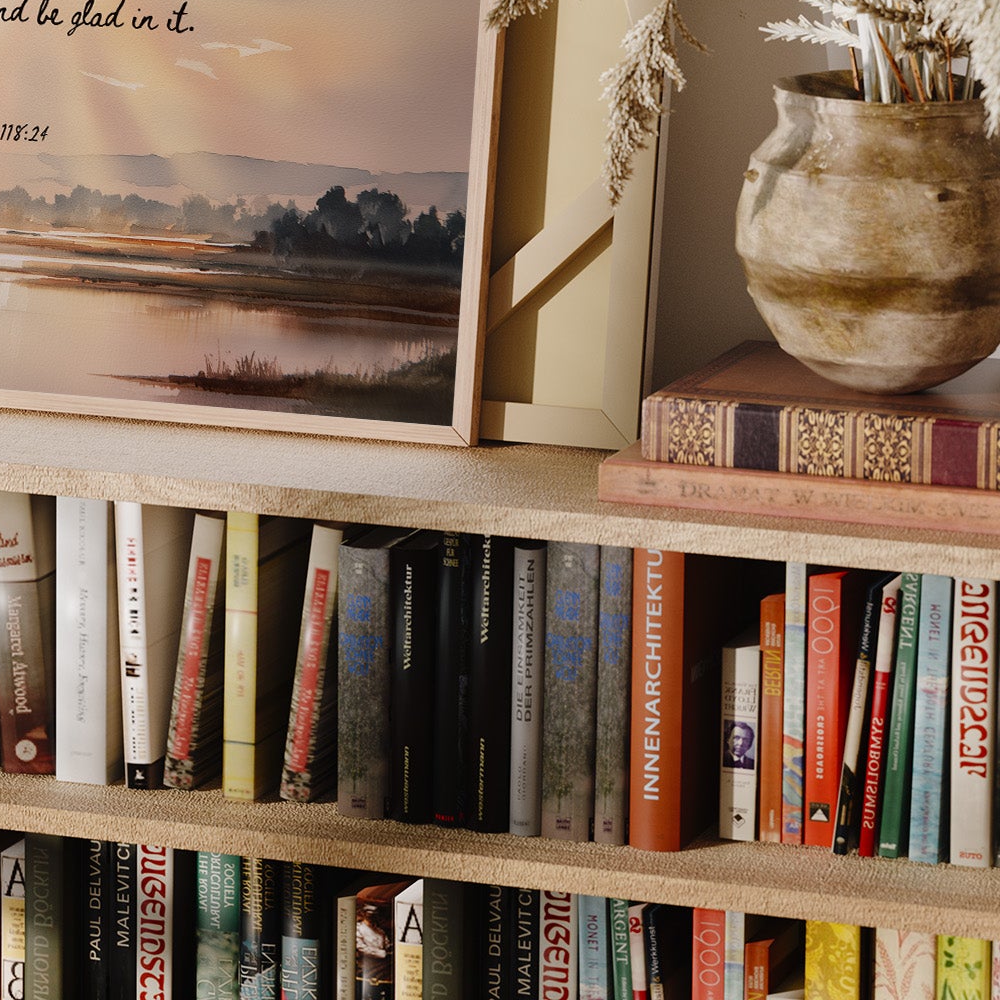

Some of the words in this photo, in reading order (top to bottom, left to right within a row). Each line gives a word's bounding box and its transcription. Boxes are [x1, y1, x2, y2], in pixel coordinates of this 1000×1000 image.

[131, 7, 158, 31] in
[166, 1, 195, 34] it.
[0, 121, 49, 142] 118:24
[6, 594, 24, 657] Margaret
[403, 564, 413, 670] Weltarchitektur
[524, 559, 535, 679] PRIMZAHLEN
[12, 661, 32, 714] Atwood
[524, 685, 533, 721] DER
[643, 549, 663, 801] INNENARCHITEKTU
[402, 746, 410, 814] westermann
[477, 737, 486, 821] westermann
[89, 916, 102, 961] PAUL
[587, 914, 599, 951] MONET
[649, 926, 659, 974] Werkkunst
[694, 921, 720, 987] 1900
